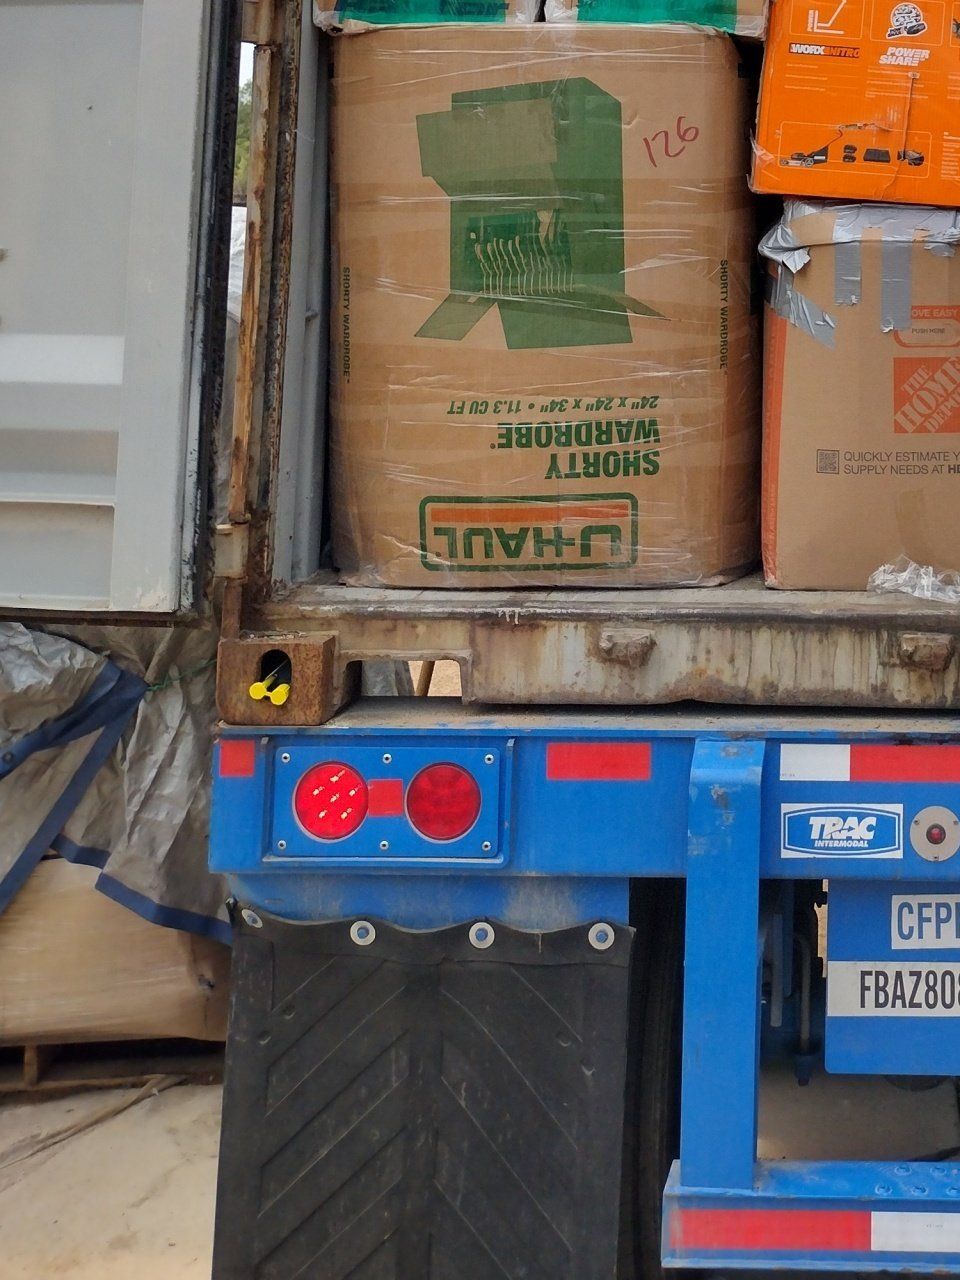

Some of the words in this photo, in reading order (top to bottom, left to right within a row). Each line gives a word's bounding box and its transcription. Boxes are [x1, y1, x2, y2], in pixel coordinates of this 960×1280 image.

[790, 43, 825, 55] WORX
[824, 46, 860, 58] NITRO
[886, 46, 931, 59] POWER
[879, 55, 920, 67] SHARE
[642, 115, 699, 167] 126
[342, 266, 351, 310] SHORTY
[719, 260, 729, 302] SHORTY
[911, 308, 932, 318] OVE
[933, 308, 958, 318] EASY
[342, 313, 351, 377] WARDROBE
[719, 306, 729, 370] WARDROBE
[902, 365, 932, 396] THE
[447, 400, 466, 415] FT
[468, 400, 489, 414] CU
[493, 400, 522, 414] 11.3
[497, 417, 661, 449] WARDROBE
[544, 448, 661, 480] SHORTY
[843, 451, 893, 462] QUICKLY
[896, 451, 950, 462] ESTIMATE
[843, 464, 887, 475] SUPPLY
[890, 463, 929, 475] NEEDS
[930, 463, 945, 474] AT
[434, 524, 622, 559] U-HAUL
[808, 816, 877, 840] TRAC
[814, 840, 869, 848] INTERMODAL
